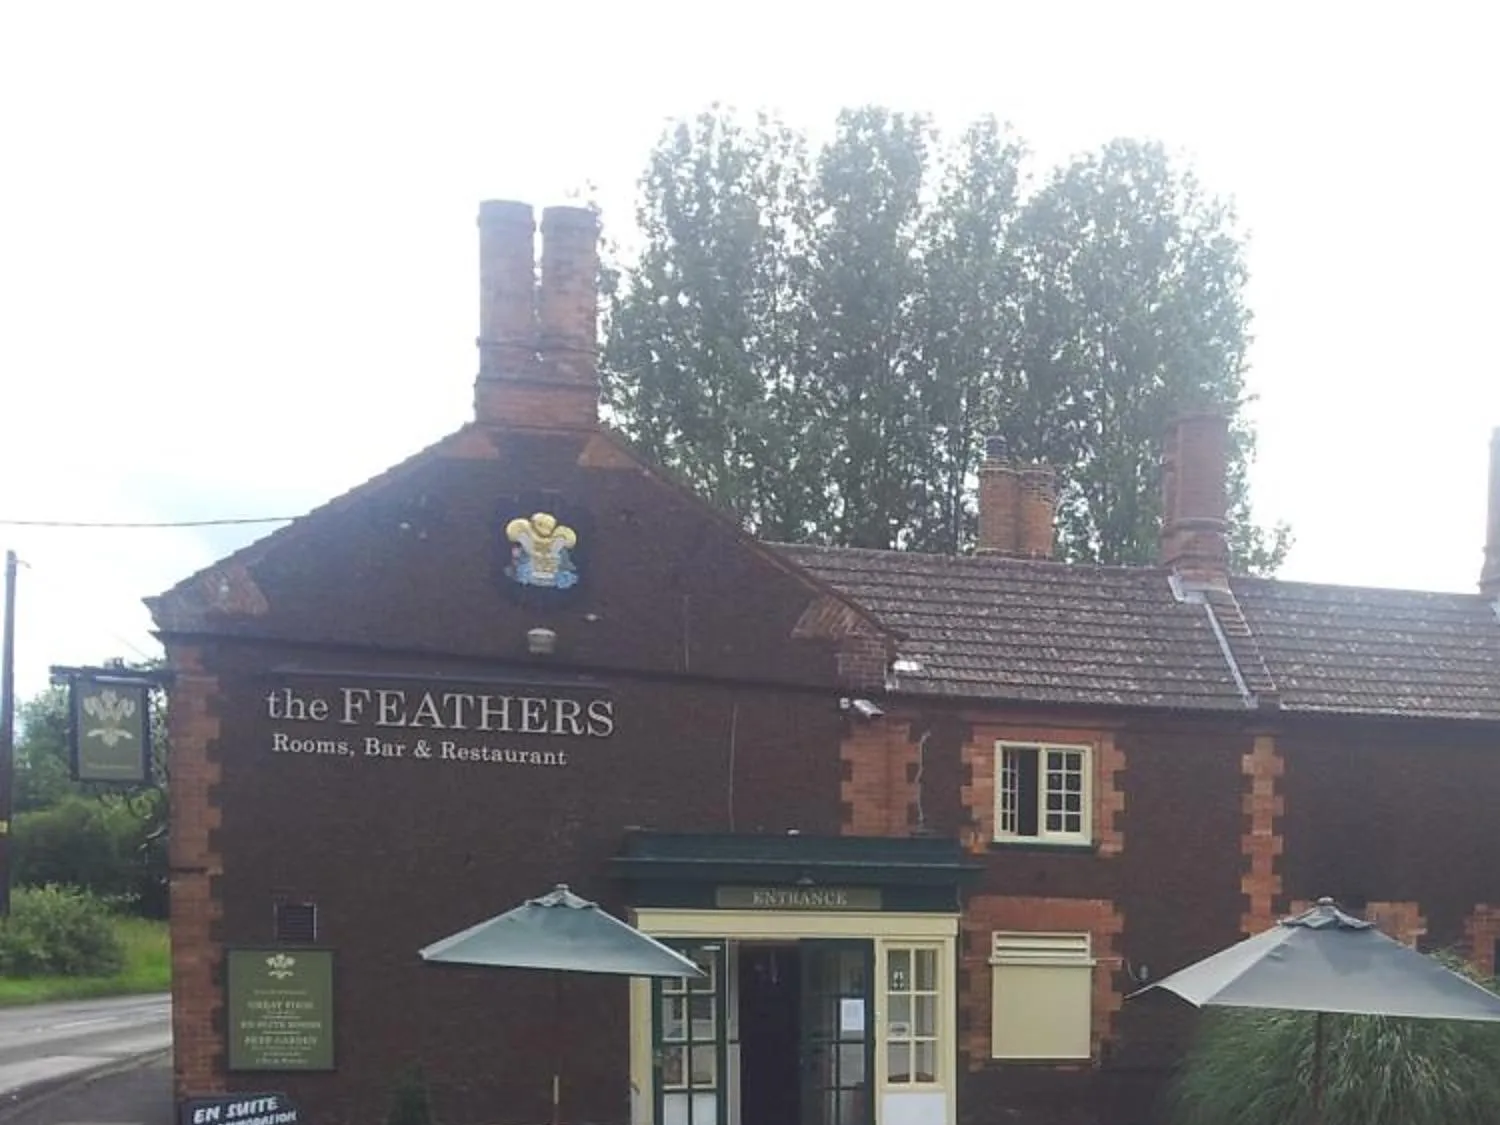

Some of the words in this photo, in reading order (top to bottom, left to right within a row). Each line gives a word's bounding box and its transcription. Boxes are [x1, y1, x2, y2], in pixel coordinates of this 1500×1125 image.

[266, 687, 329, 721] the
[339, 687, 615, 737] FEATHERS
[272, 733, 355, 756] Rooms,
[365, 737, 406, 758] Bar
[413, 739, 433, 759] &
[441, 741, 568, 766] Restaurant
[752, 888, 848, 906] ENTRANCE
[193, 1106, 220, 1125] EN
[226, 1096, 279, 1118] SUITE
